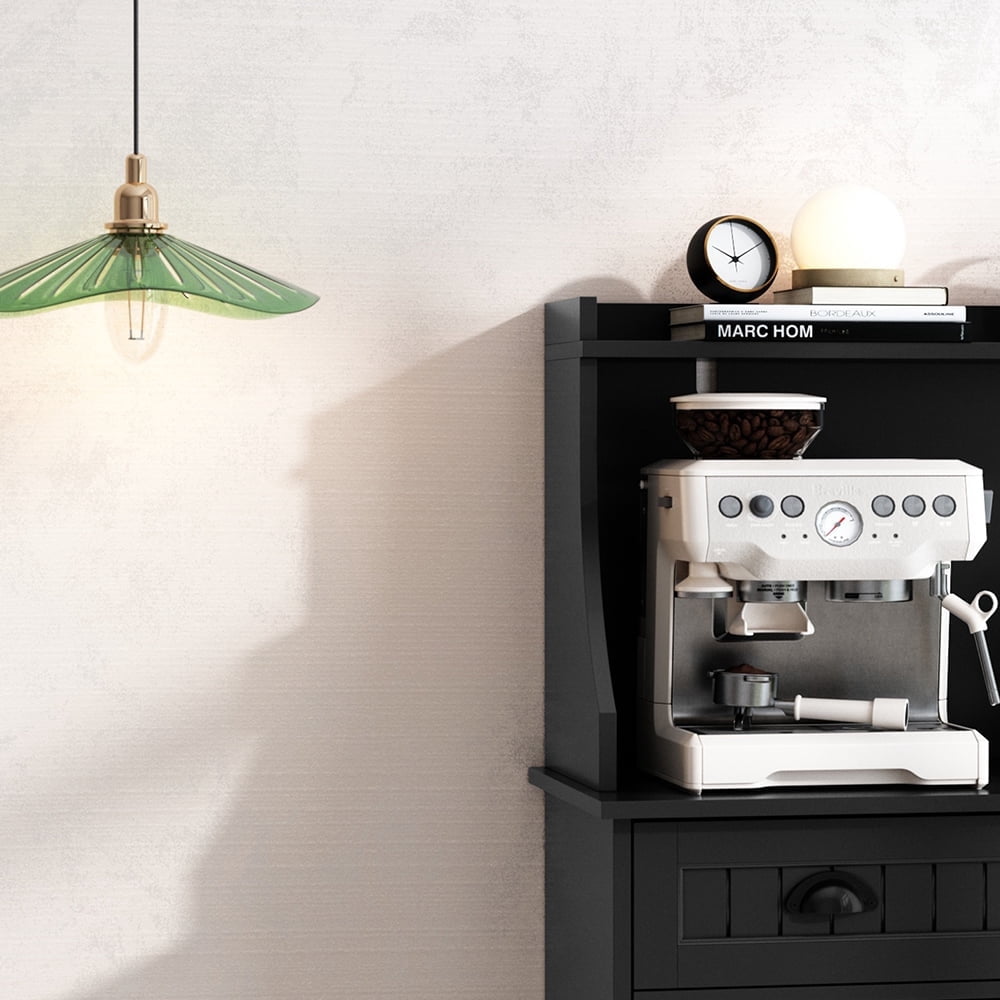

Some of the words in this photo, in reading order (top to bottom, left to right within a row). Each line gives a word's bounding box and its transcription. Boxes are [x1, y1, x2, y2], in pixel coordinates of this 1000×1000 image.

[809, 309, 876, 318] BORDEAUX
[717, 324, 769, 338] MARC
[773, 324, 813, 338] HOM
